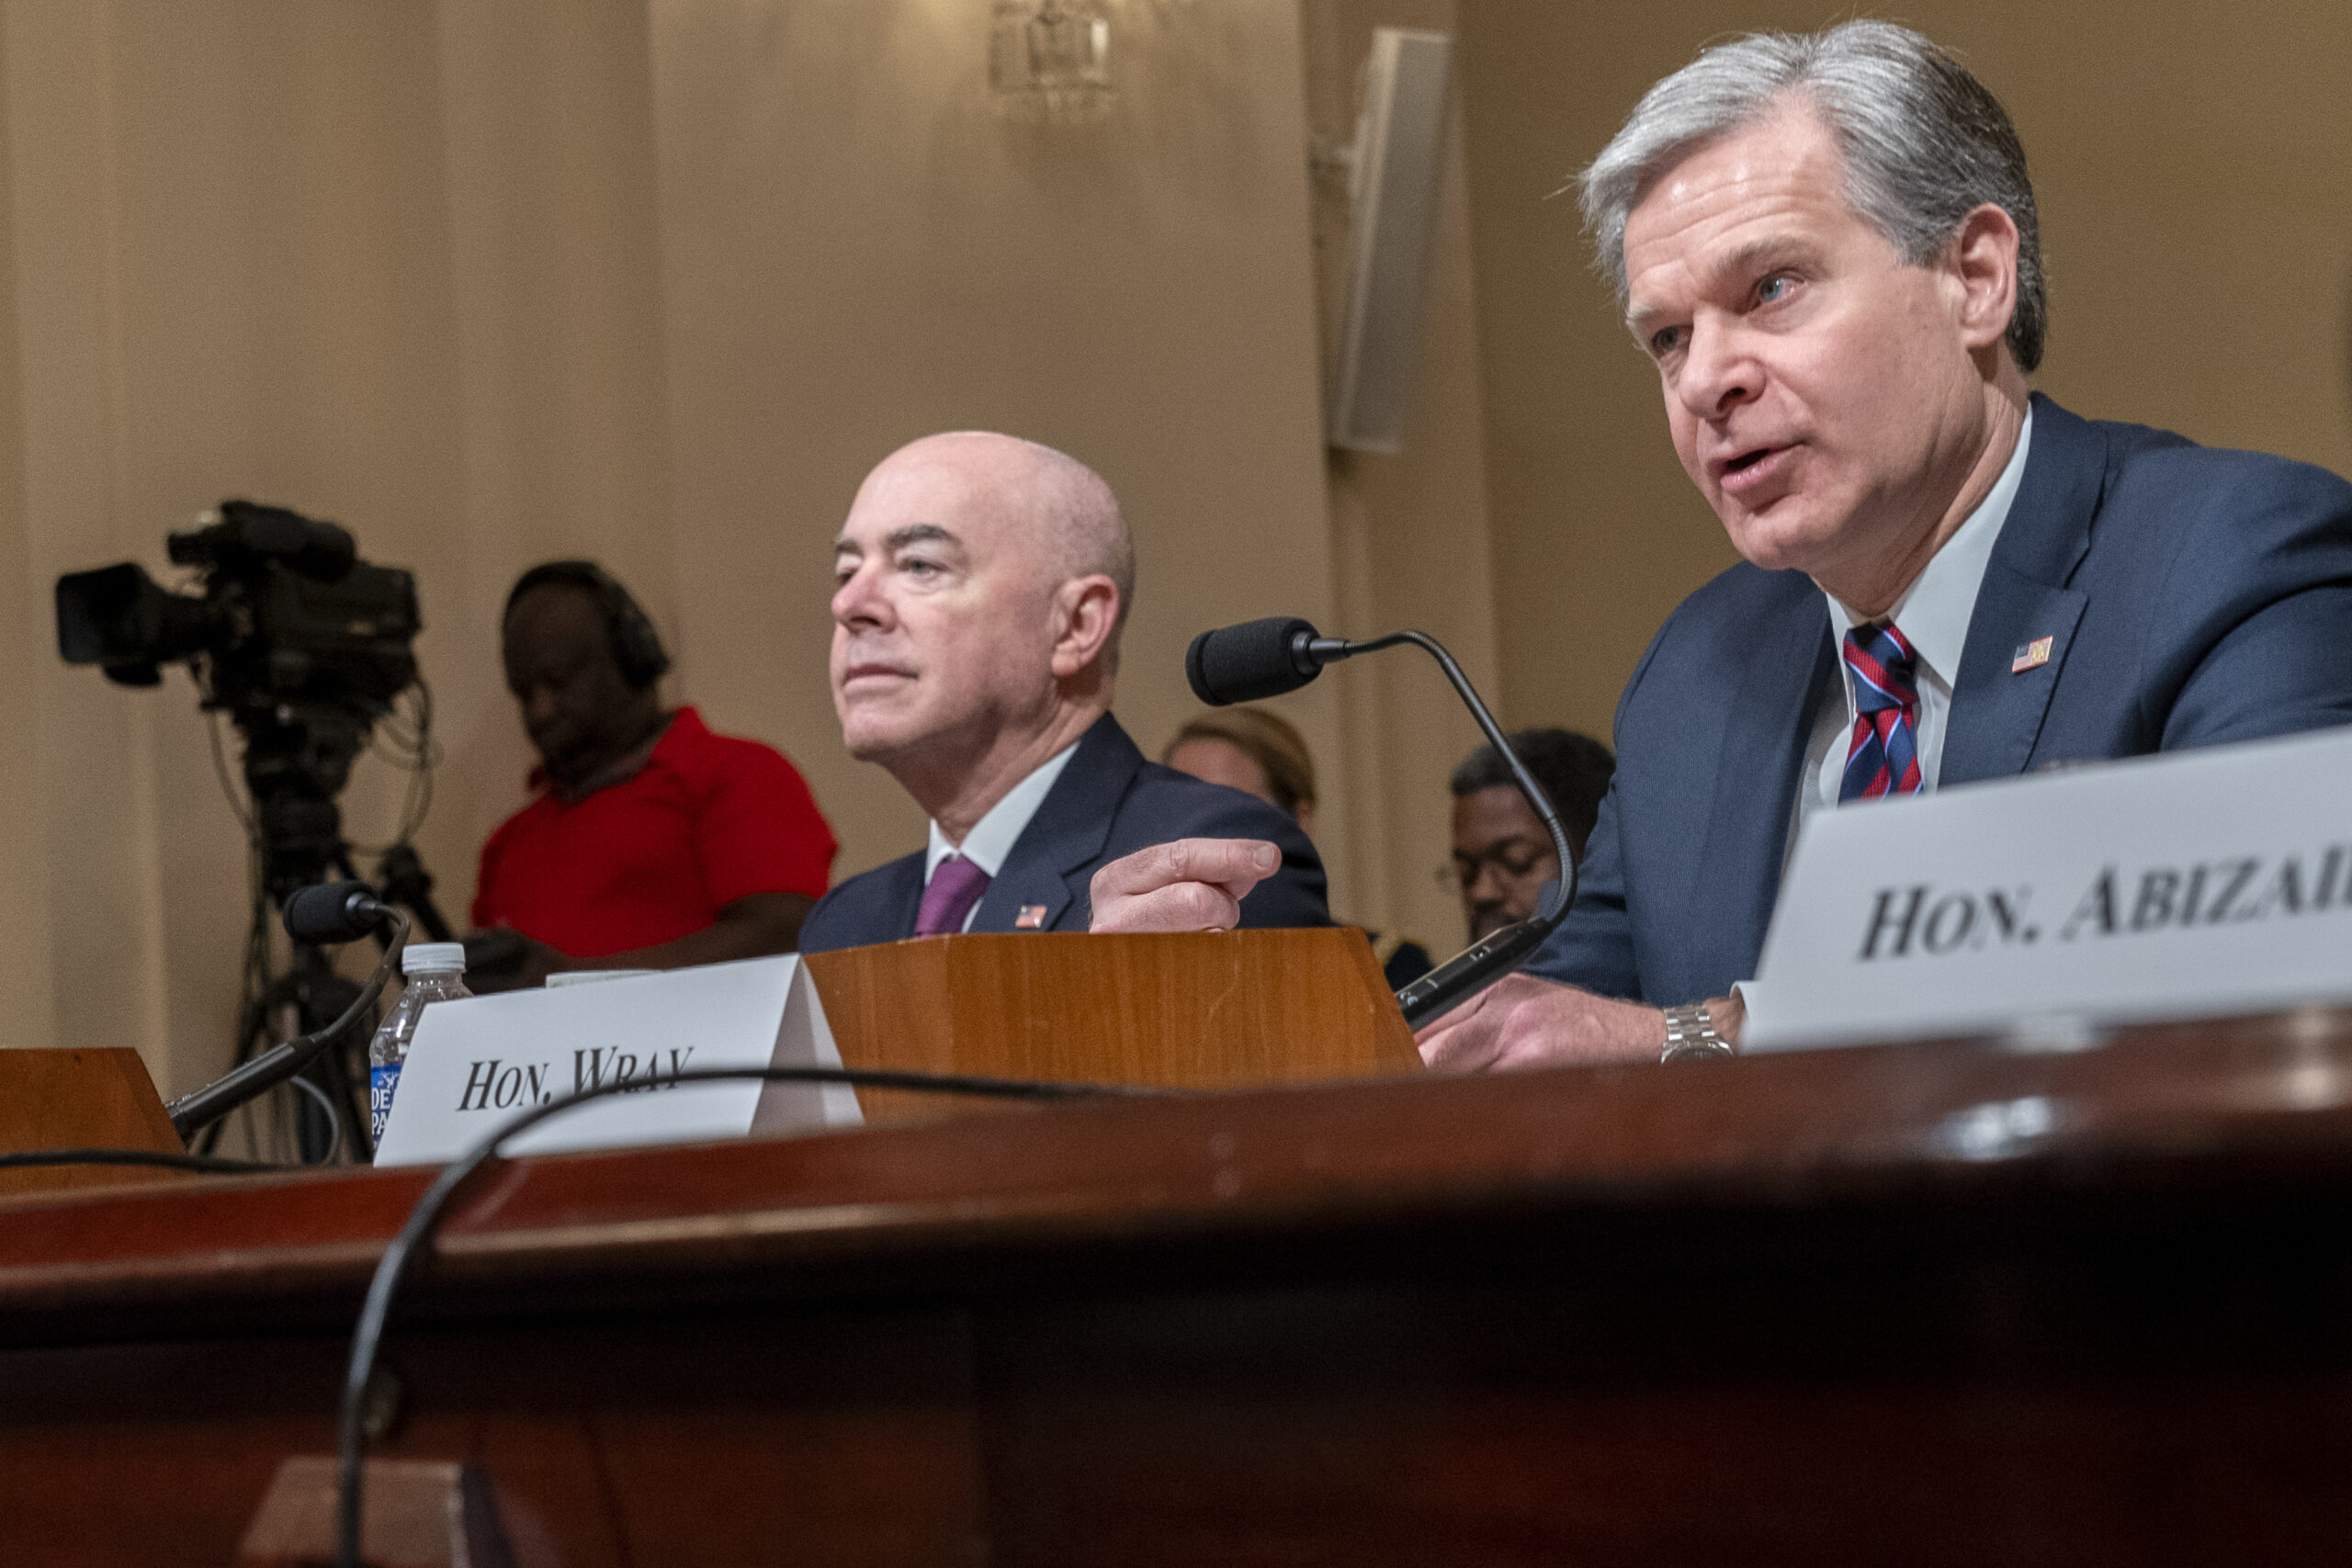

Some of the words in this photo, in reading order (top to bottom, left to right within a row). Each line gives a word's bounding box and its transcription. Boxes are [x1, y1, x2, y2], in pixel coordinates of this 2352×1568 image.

[1858, 884, 2041, 961] HON.
[2061, 843, 2352, 939] ABIZAI
[456, 1059, 551, 1111] HON.
[573, 1045, 695, 1096] WRAY
